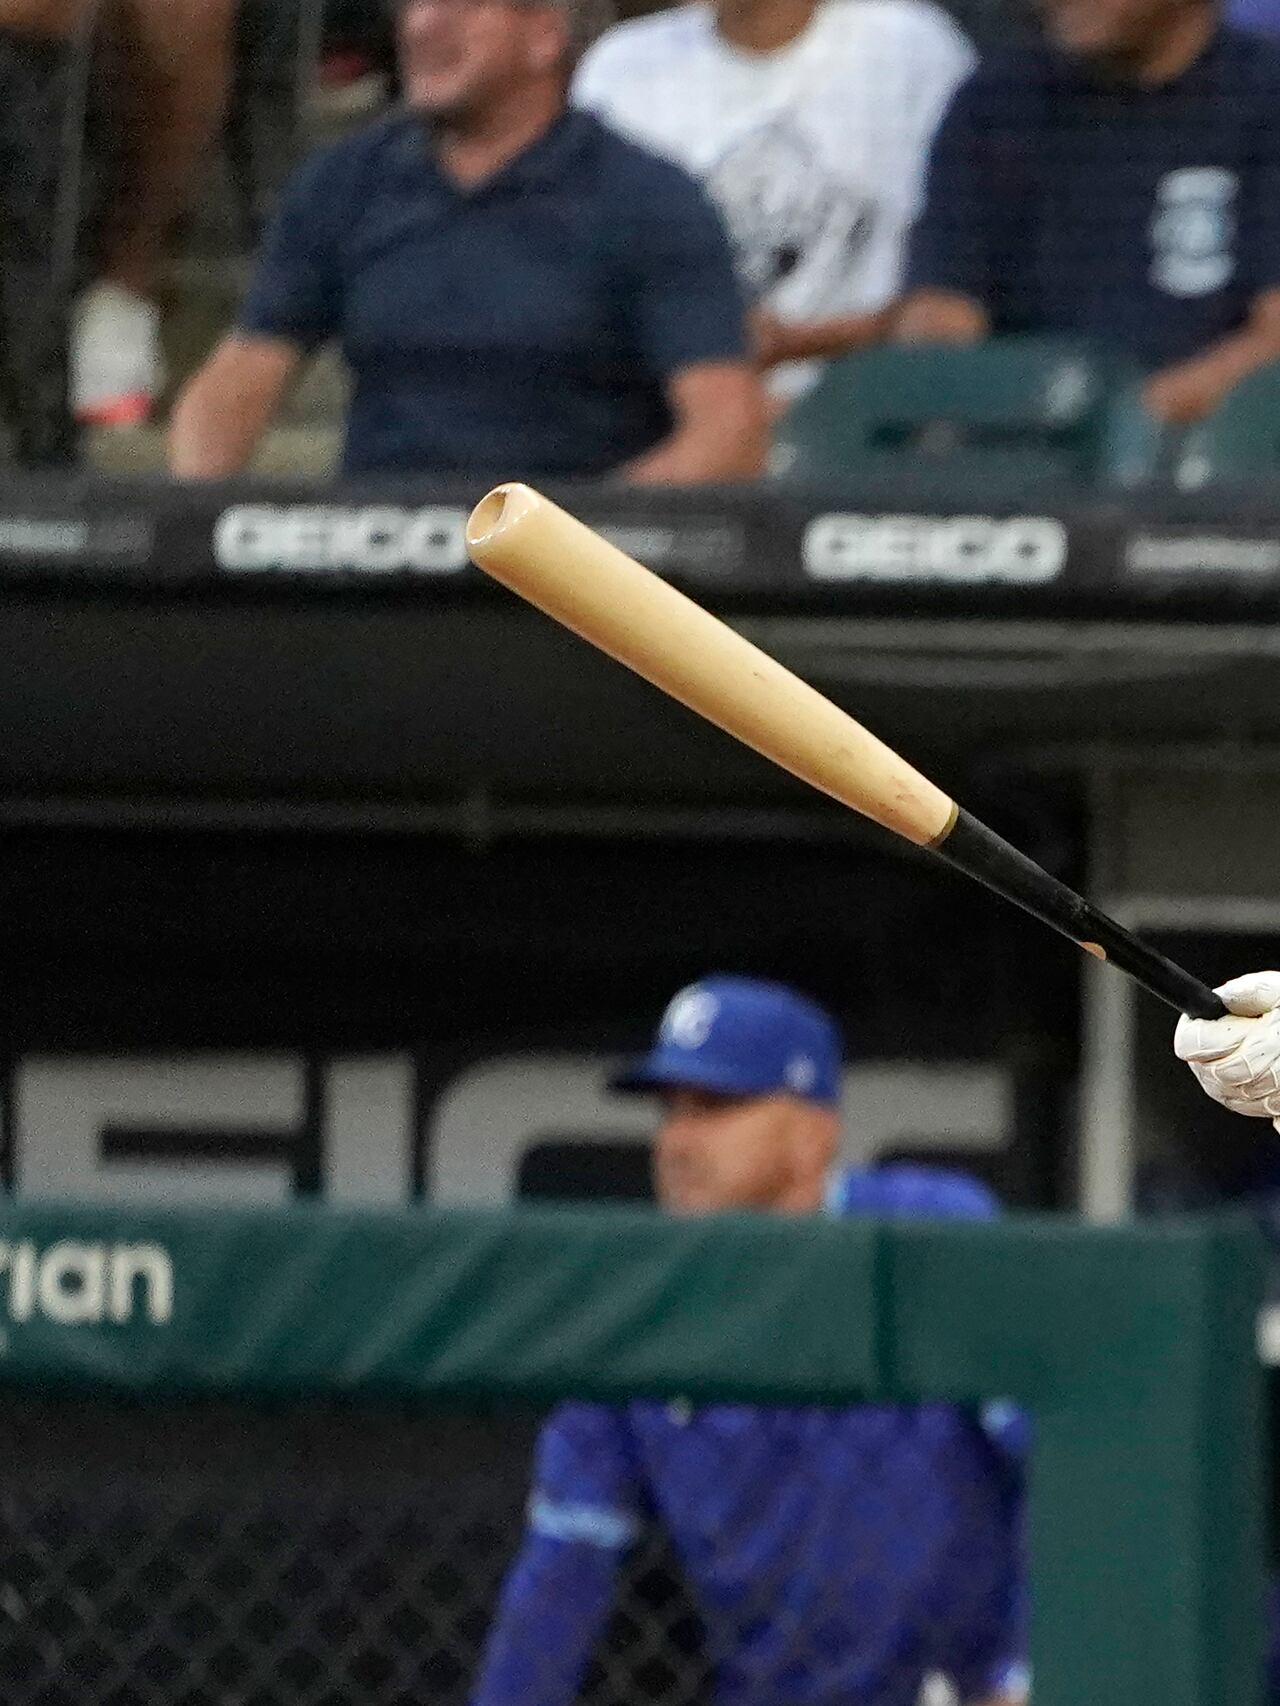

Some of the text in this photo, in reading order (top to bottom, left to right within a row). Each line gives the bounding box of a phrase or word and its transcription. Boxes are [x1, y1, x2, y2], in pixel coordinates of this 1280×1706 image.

[214, 503, 470, 573] GEICO
[803, 512, 1068, 582] GEICO
[0, 1239, 174, 1327] ian
